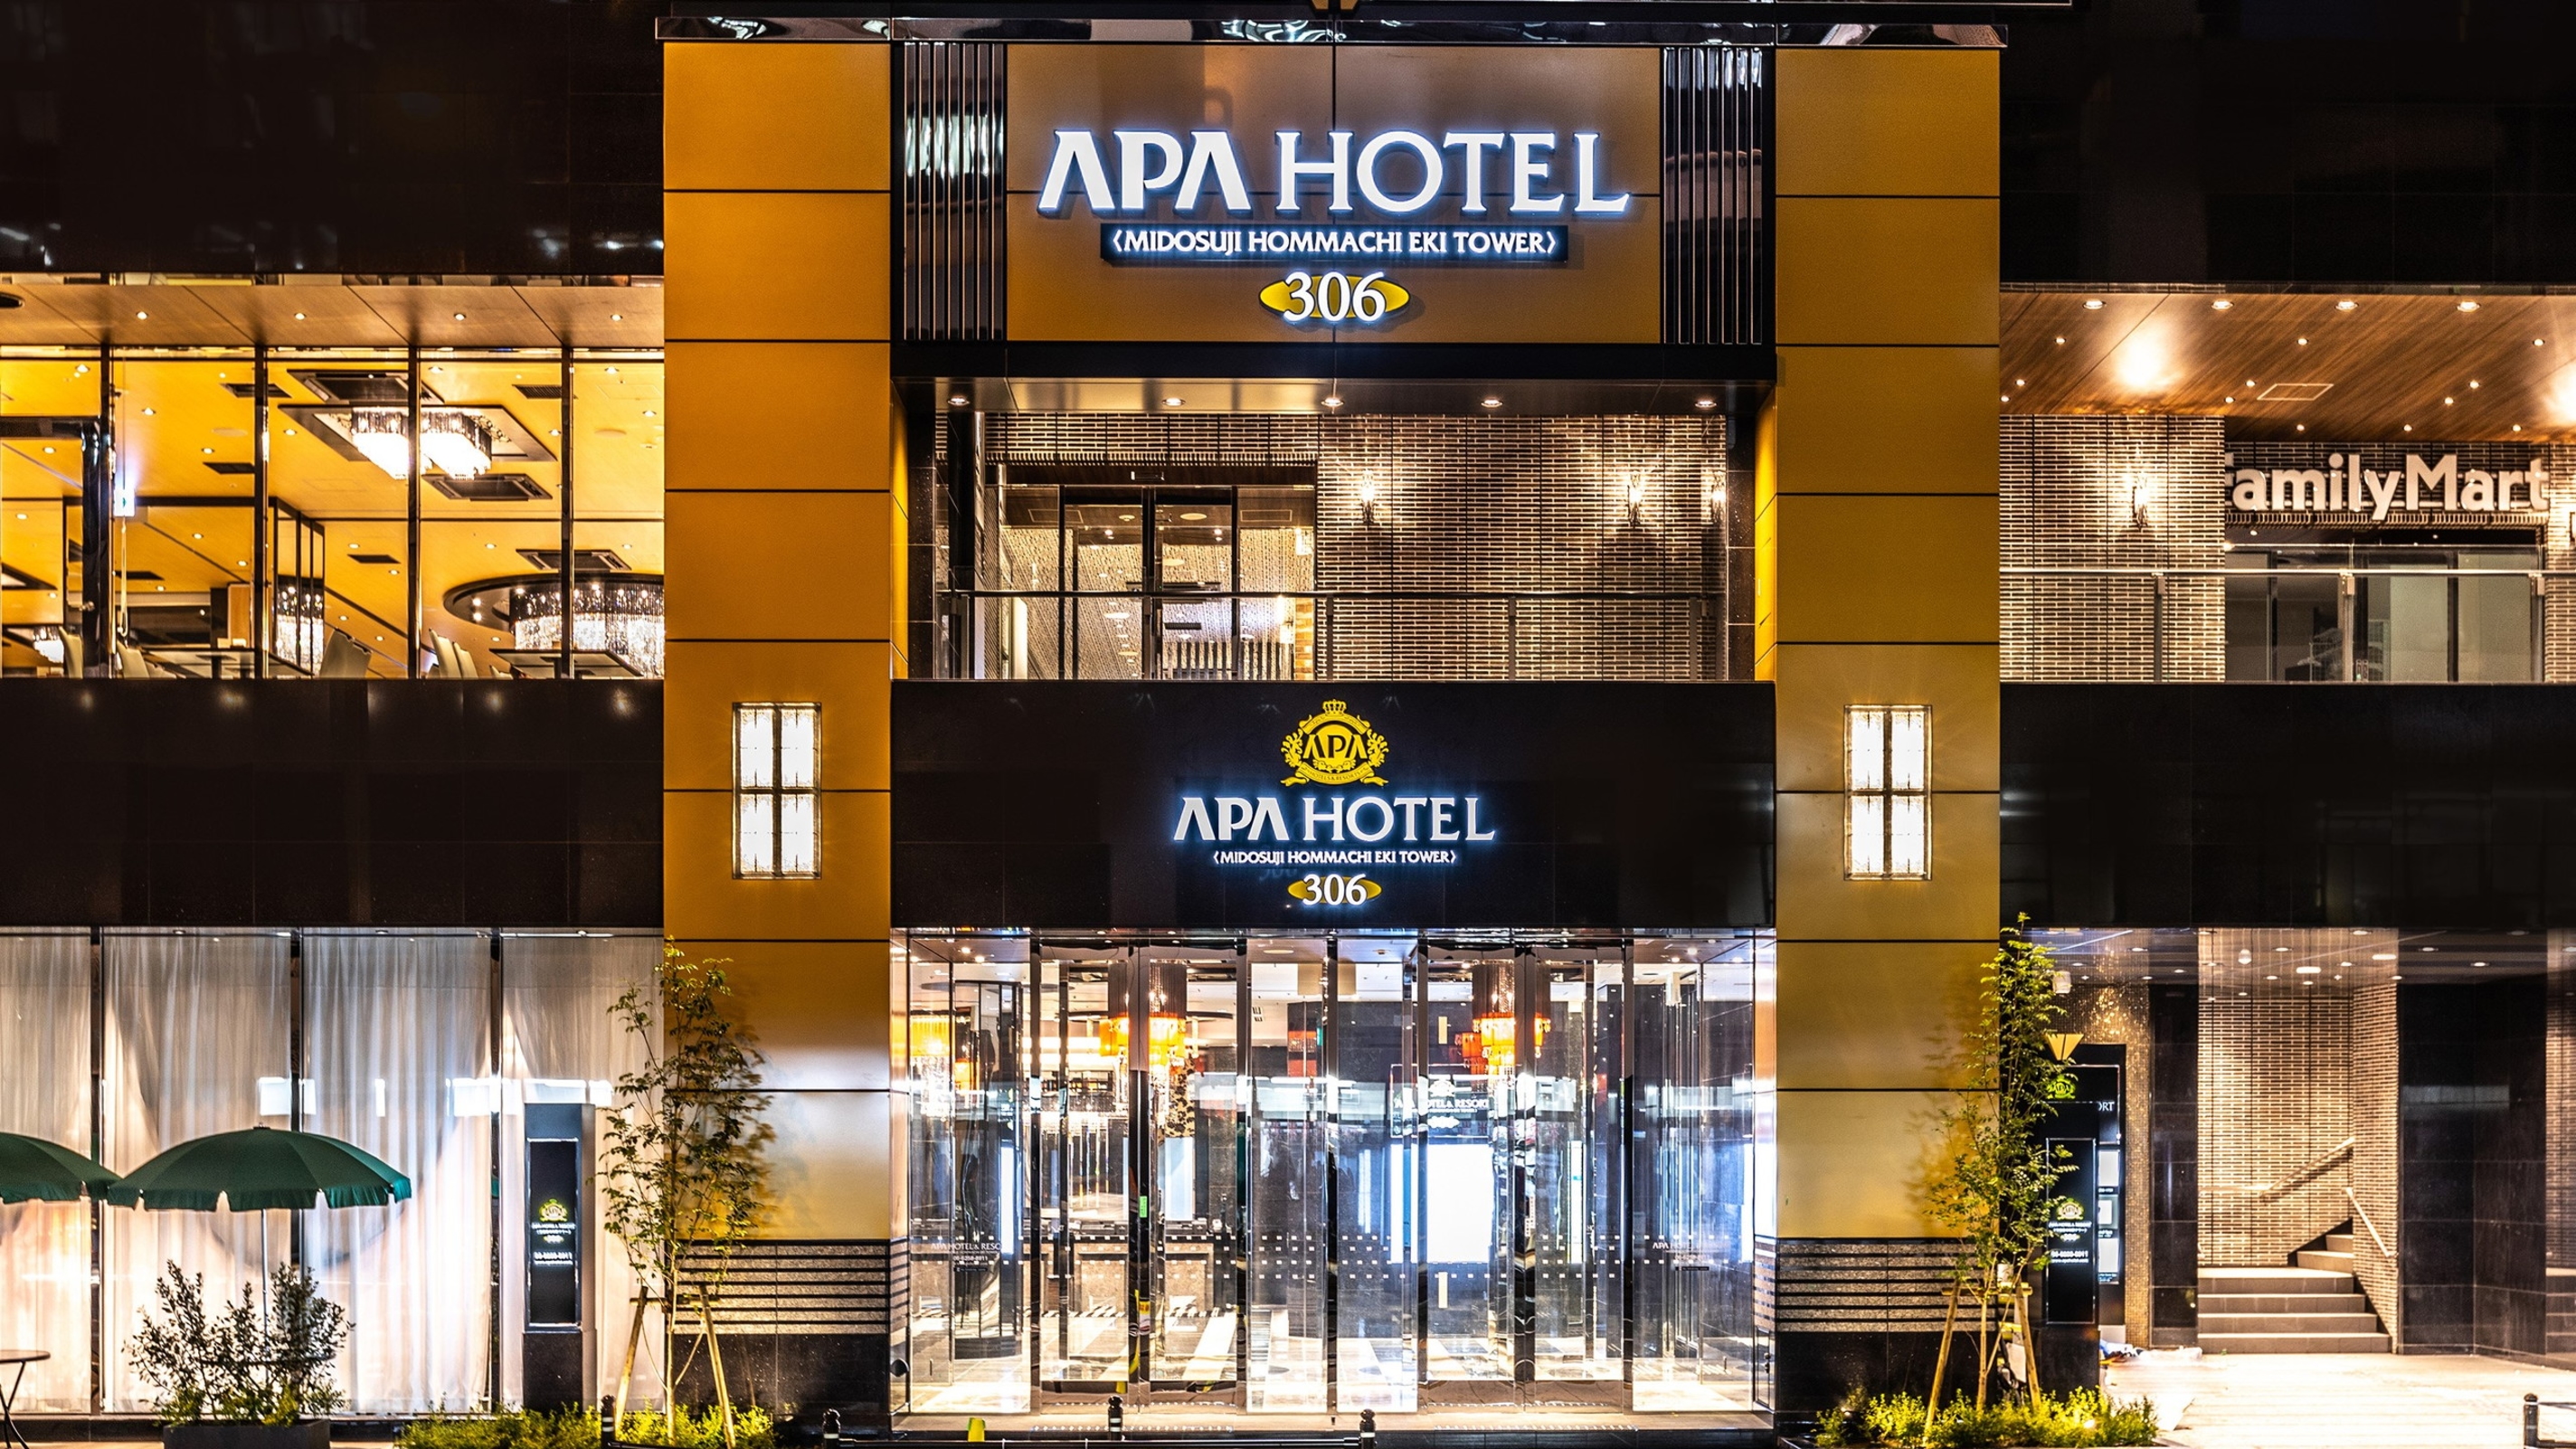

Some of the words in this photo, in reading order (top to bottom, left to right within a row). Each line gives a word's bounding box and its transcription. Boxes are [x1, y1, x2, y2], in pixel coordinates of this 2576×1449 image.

[1037, 130, 1253, 213] APA
[1274, 129, 1630, 213] HOTEL
[1248, 231, 1403, 253] HOMMACHI
[1408, 231, 1447, 253] EKI
[1283, 271, 1387, 322] 306
[1302, 734, 1368, 759] APA
[1174, 797, 1291, 841] APA
[1302, 796, 1496, 842] HOTEL
[1287, 850, 1373, 864] HOMMACHI
[1375, 850, 1397, 864] EKI
[1302, 874, 1368, 905] 306
